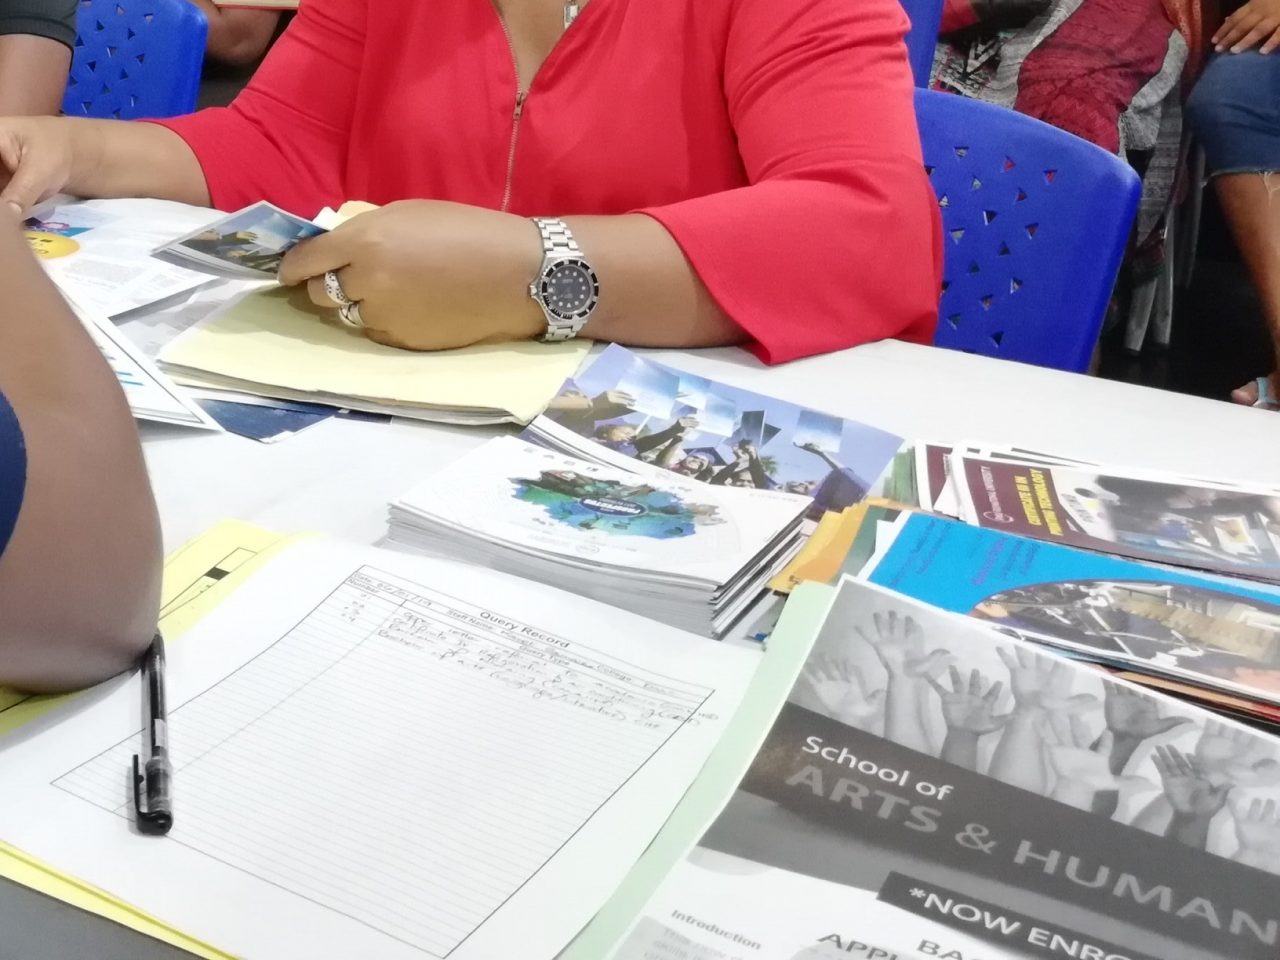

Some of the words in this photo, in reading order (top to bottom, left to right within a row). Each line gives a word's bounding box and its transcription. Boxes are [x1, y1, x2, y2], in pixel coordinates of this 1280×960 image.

[480, 611, 520, 631] Query
[520, 627, 571, 649] Record
[801, 735, 910, 787] School
[915, 781, 955, 801] of
[784, 764, 943, 834] ARTS
[954, 822, 997, 854] &
[671, 909, 762, 951] Introduction
